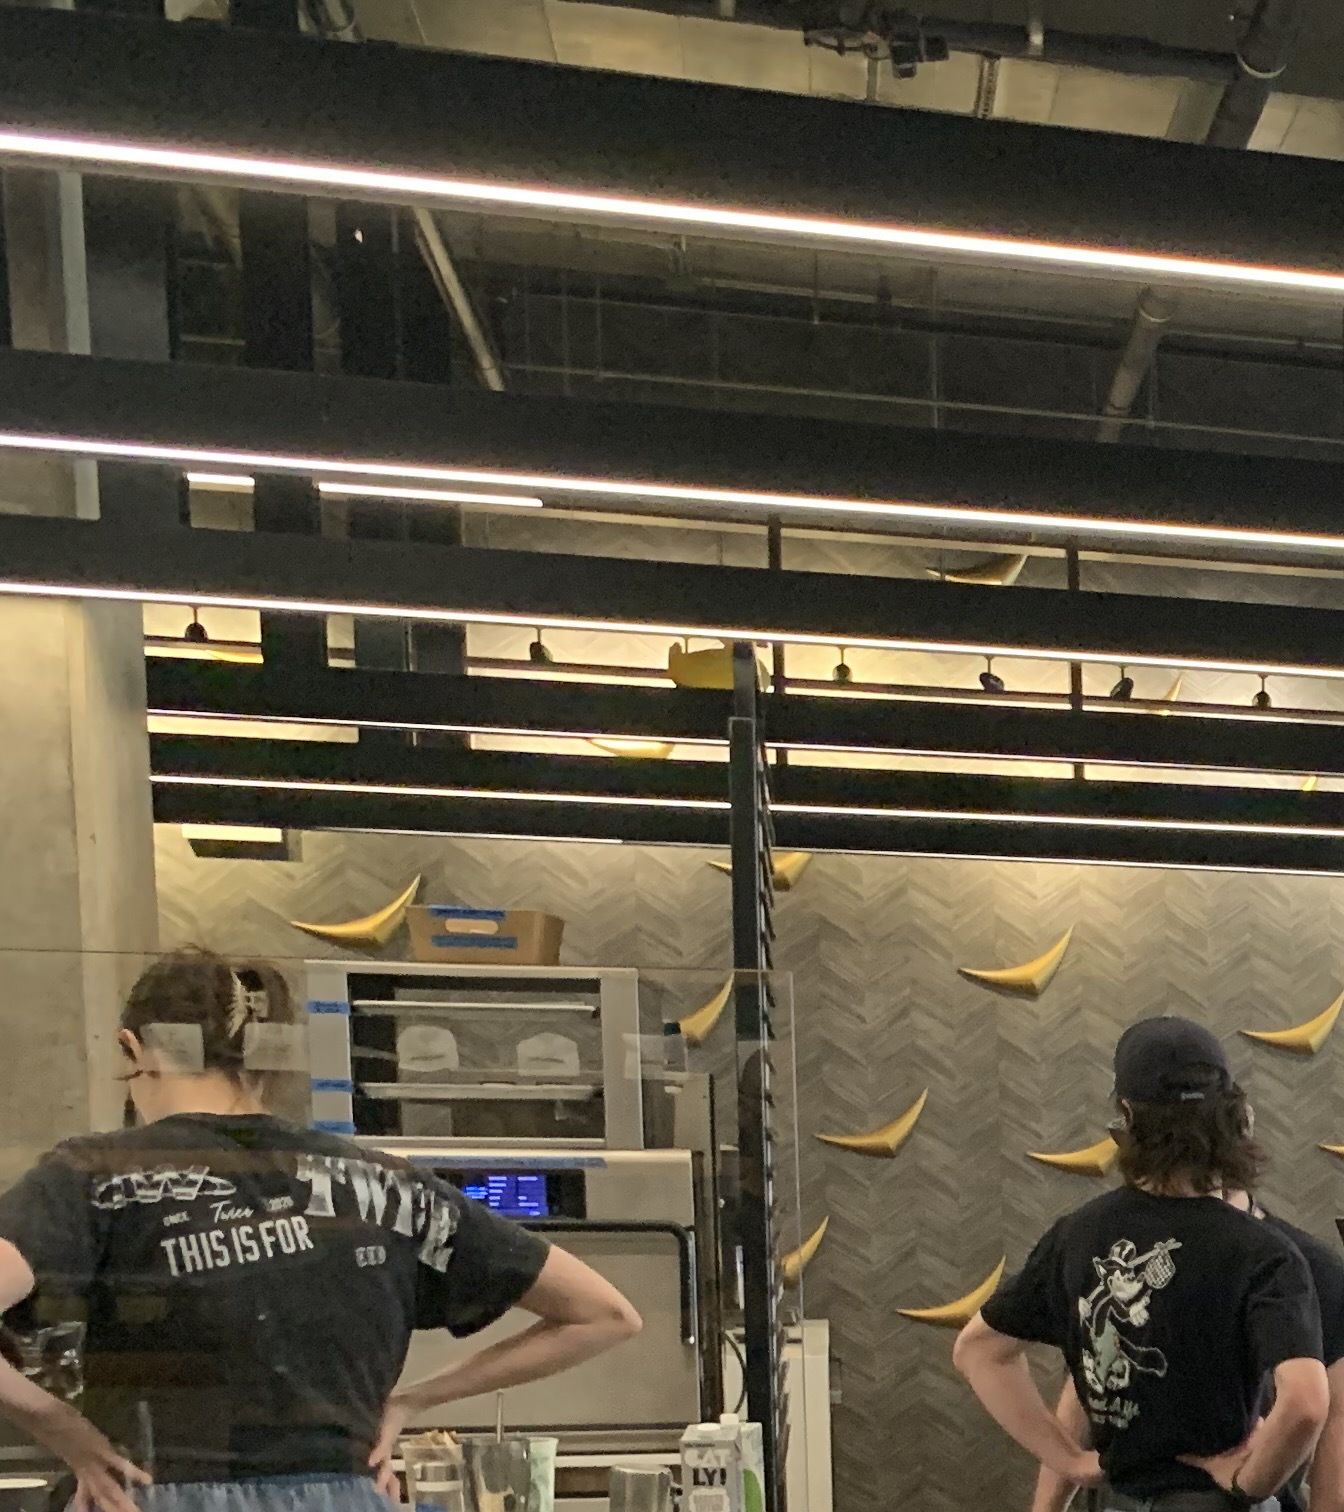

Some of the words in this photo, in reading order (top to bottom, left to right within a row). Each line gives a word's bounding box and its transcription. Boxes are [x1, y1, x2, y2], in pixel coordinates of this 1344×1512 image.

[160, 1229, 231, 1277] THIS
[231, 1225, 260, 1264] IS
[258, 1216, 314, 1258] FOR
[692, 1467, 727, 1485] LY!
